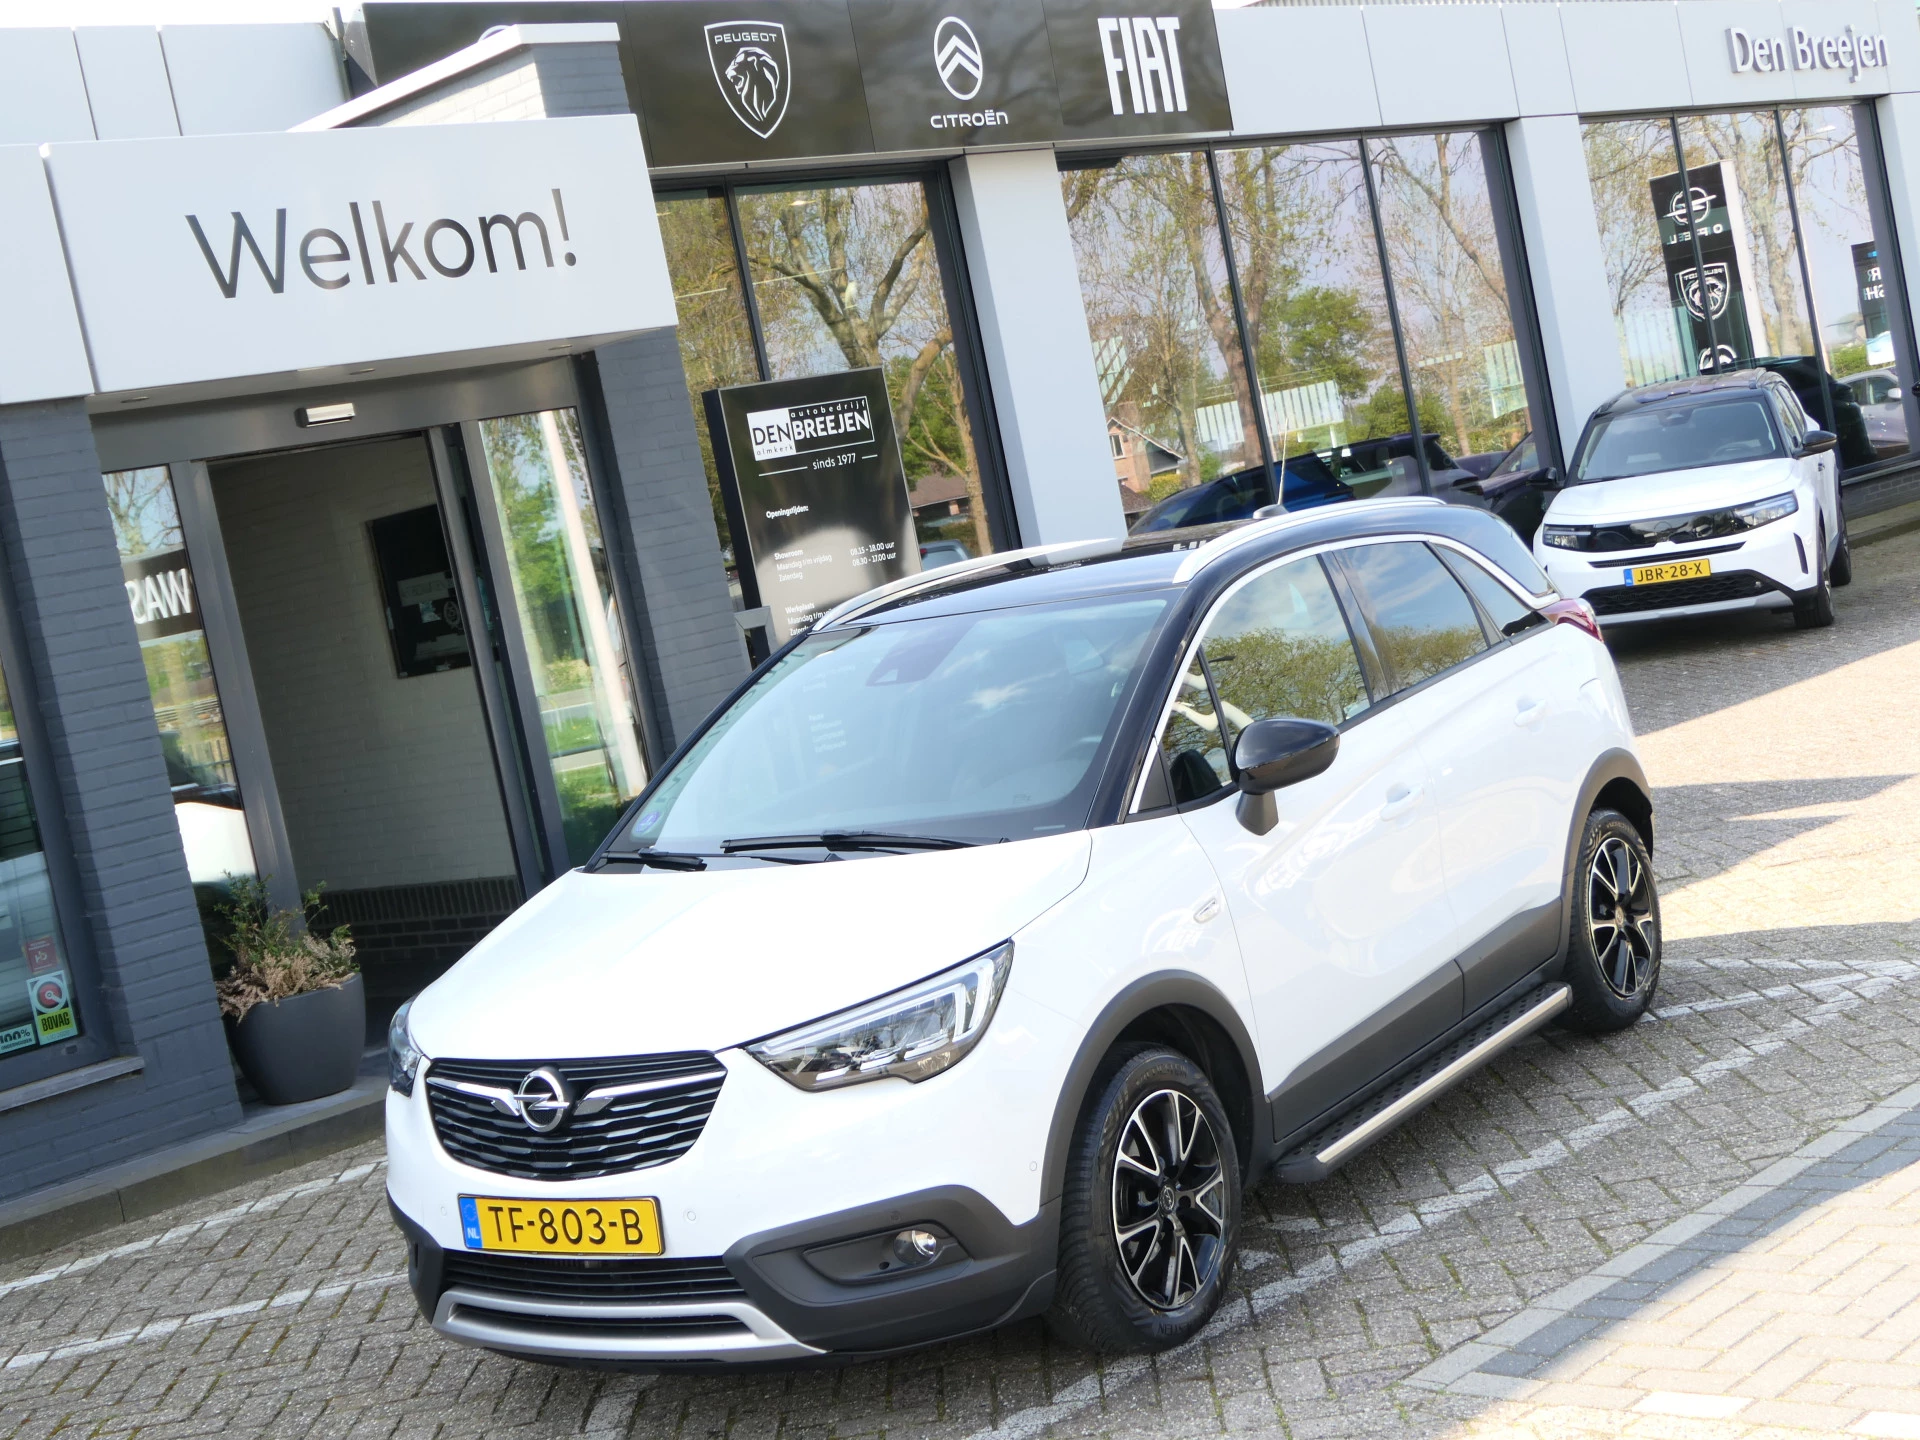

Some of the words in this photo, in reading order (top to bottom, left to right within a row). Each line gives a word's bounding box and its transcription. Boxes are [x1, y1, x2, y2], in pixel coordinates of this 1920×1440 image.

[714, 31, 777, 45] PEUGEOT
[1725, 27, 1788, 73] Den
[1787, 24, 1891, 83] Breejen
[1097, 16, 1188, 115] FIAT
[184, 187, 577, 299] Welkom!
[790, 399, 866, 418] autobedrijf
[752, 423, 792, 446] DEN
[791, 410, 870, 440] BREEJEN
[812, 457, 836, 470] sinds
[837, 452, 856, 466] 1977
[774, 549, 804, 560] Showroom
[885, 541, 895, 549] uur
[886, 552, 897, 560] uur
[1637, 562, 1703, 582] JBR-28-X
[785, 602, 815, 614] Werkplaats
[41, 1011, 70, 1032] BOVAG
[467, 1227, 480, 1239] NL
[487, 1205, 644, 1246] TF-803-B
